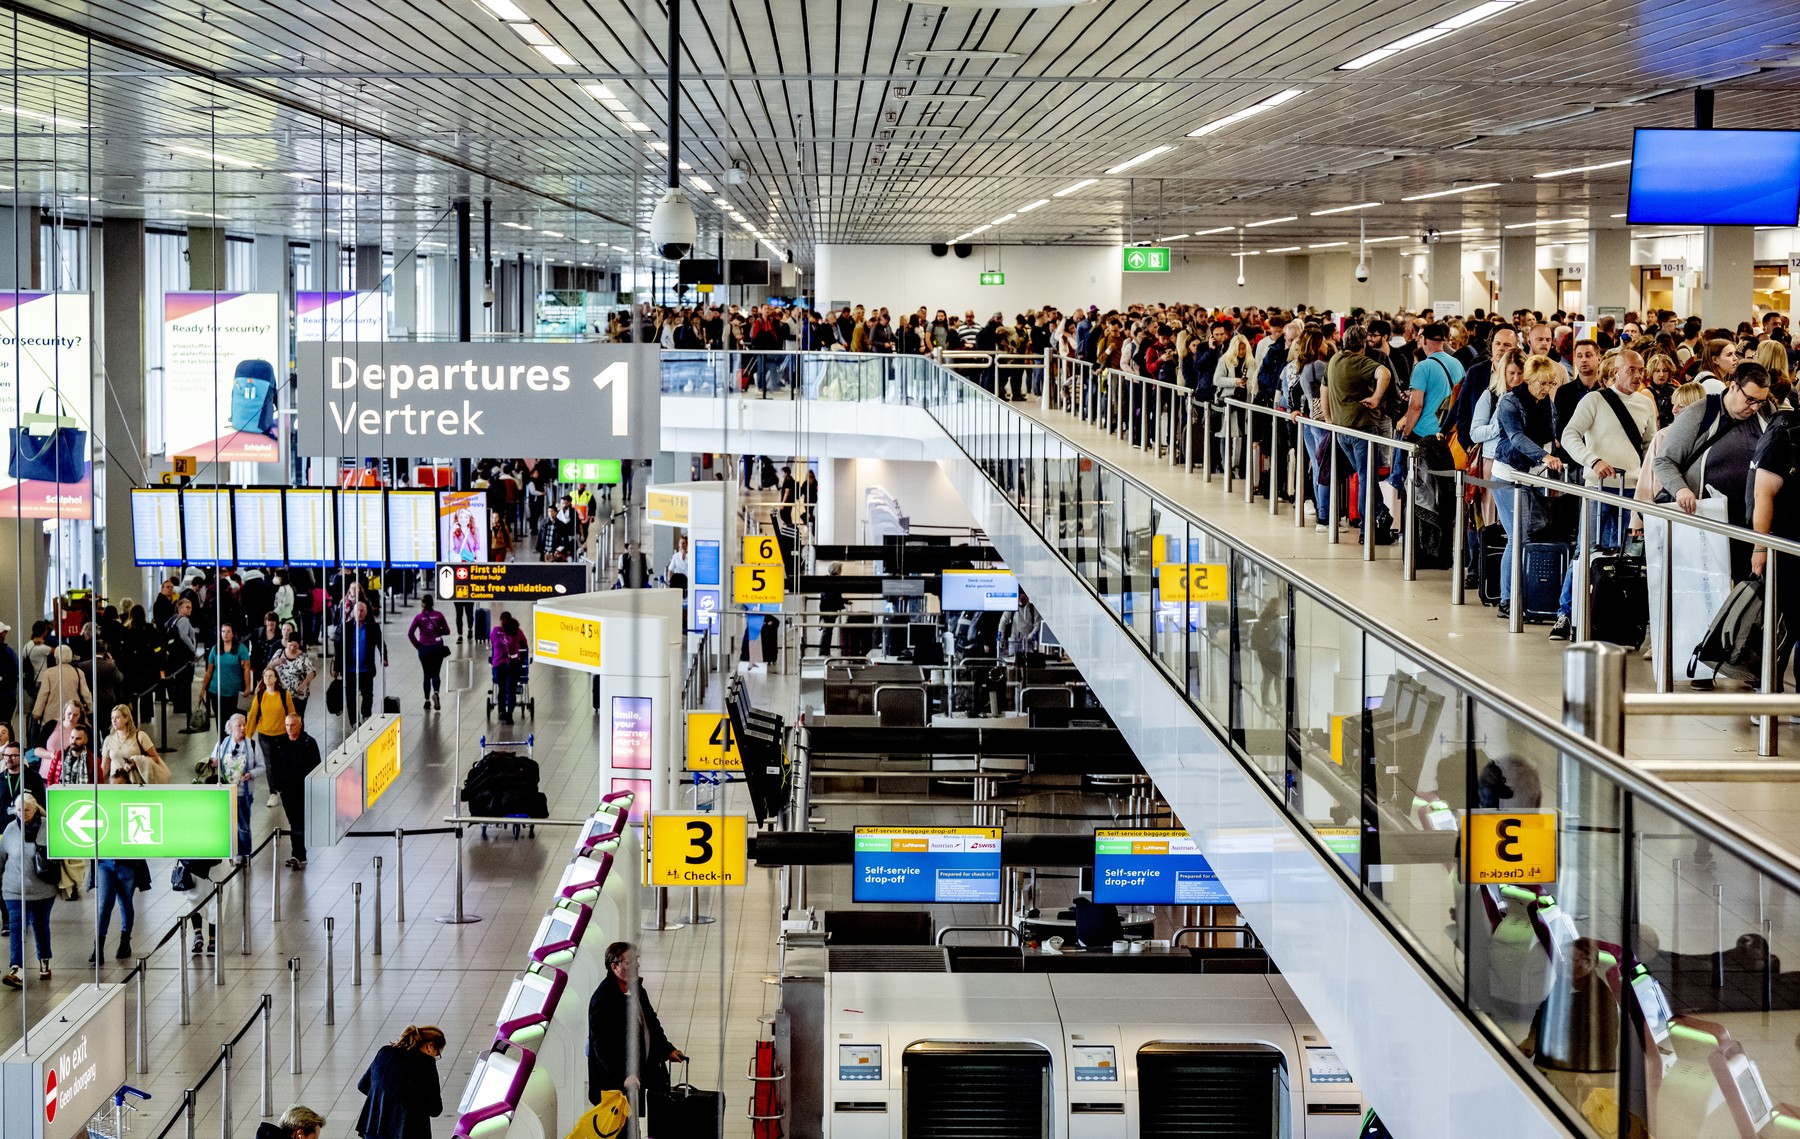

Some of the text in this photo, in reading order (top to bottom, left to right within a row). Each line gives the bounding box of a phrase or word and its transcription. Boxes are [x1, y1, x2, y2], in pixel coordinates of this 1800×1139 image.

[1663, 264, 1684, 272] 10-11
[172, 324, 270, 334] Ready for security?
[0, 334, 82, 350] or security?
[331, 356, 629, 436] Departures 1
[329, 400, 485, 435] Vertrek
[244, 443, 273, 452] Schiphol
[45, 494, 83, 505] Schiphol
[760, 539, 773, 559] 6
[470, 565, 507, 574] First aid
[488, 574, 502, 582] hulp
[751, 569, 766, 592] 5
[470, 583, 553, 593] Tax free validation
[560, 621, 593, 638] Check-in 4 5
[579, 647, 600, 661] Economy
[614, 710, 642, 721] Smile,
[614, 721, 636, 731] your
[709, 717, 735, 752] 4
[713, 757, 743, 766] Check-
[990, 829, 996, 838] 1
[1171, 830, 1191, 838] drop-
[685, 820, 714, 865] 3
[865, 866, 921, 875] Self-service
[1105, 868, 1160, 877] Self-service
[683, 871, 732, 881] Check-in
[865, 875, 906, 885] drop-off
[1105, 877, 1146, 887] drop-off
[60, 1035, 87, 1083] No exit
[60, 1063, 97, 1110] Geen doorgang
